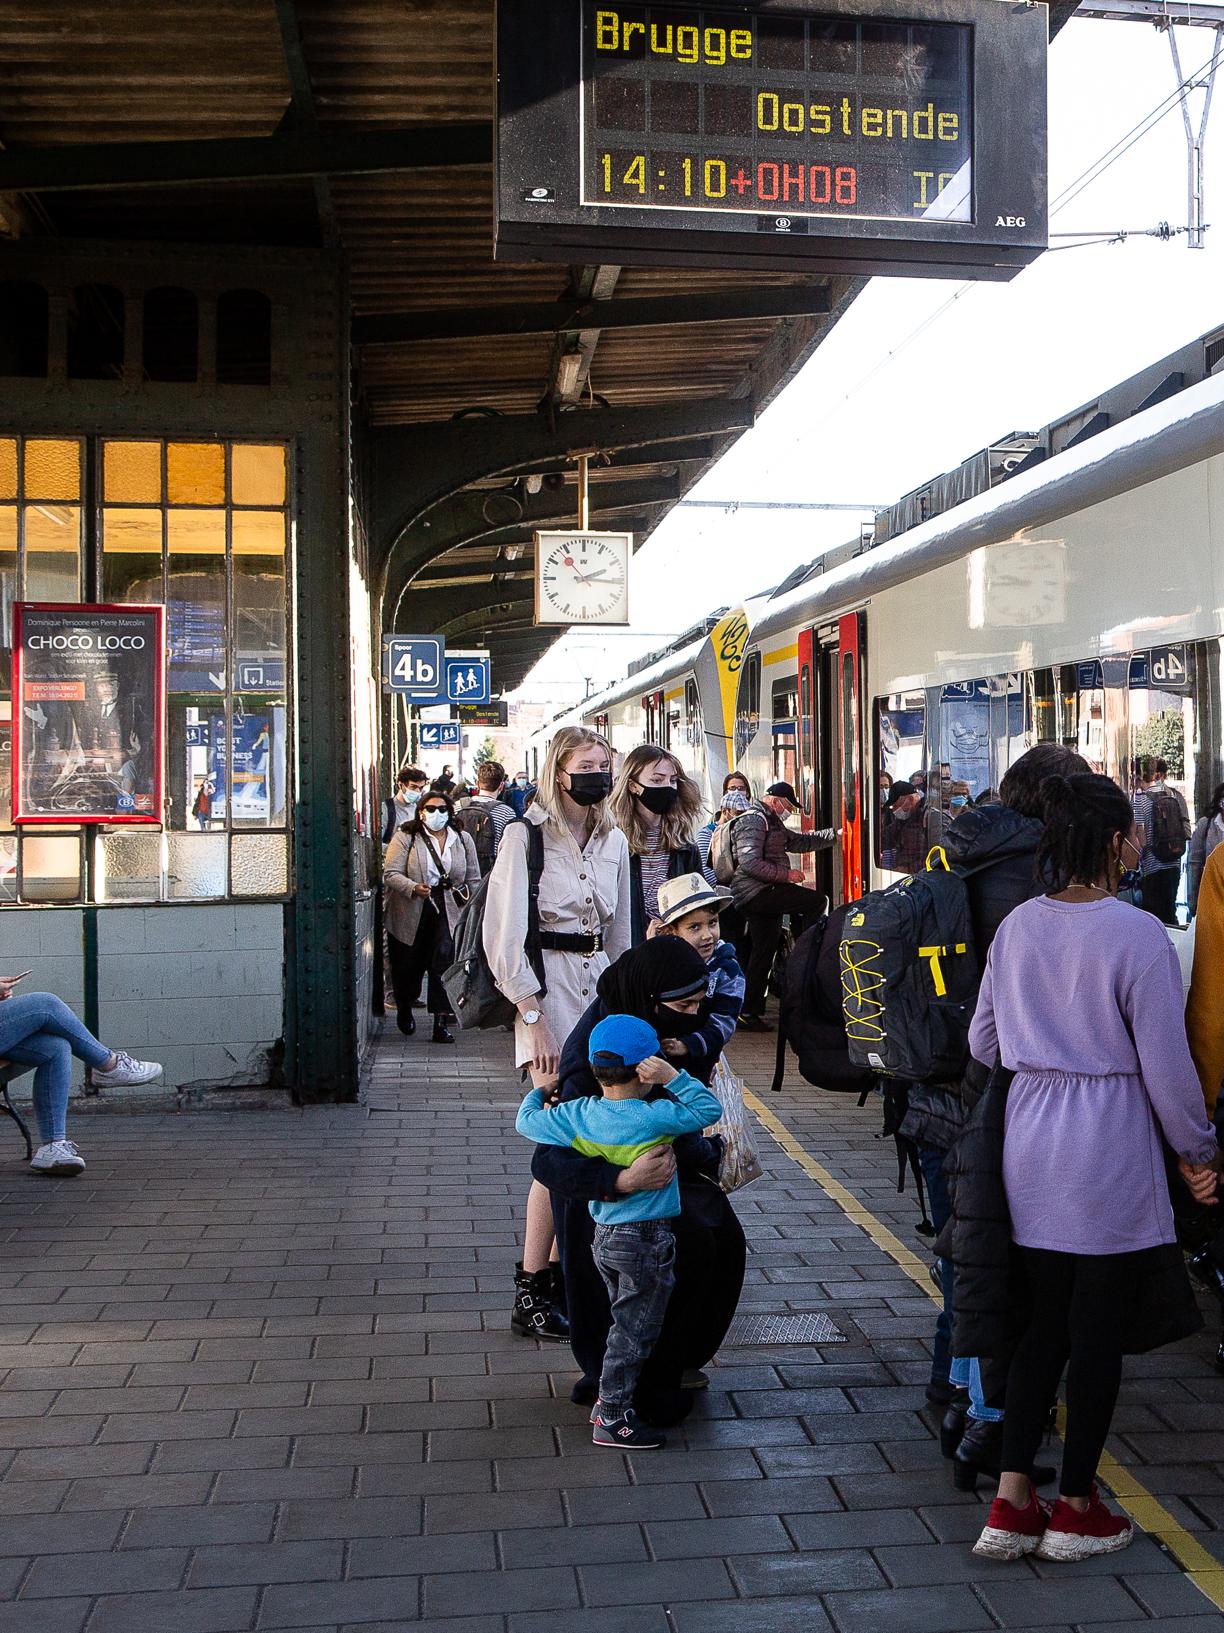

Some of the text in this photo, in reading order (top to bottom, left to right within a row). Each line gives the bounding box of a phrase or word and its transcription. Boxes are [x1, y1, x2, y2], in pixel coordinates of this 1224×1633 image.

[596, 10, 752, 65] Brugge
[757, 92, 959, 142] Oostende
[995, 216, 1026, 228] AEG
[27, 635, 146, 650] CHOCO LOCO
[394, 653, 434, 683] 4b
